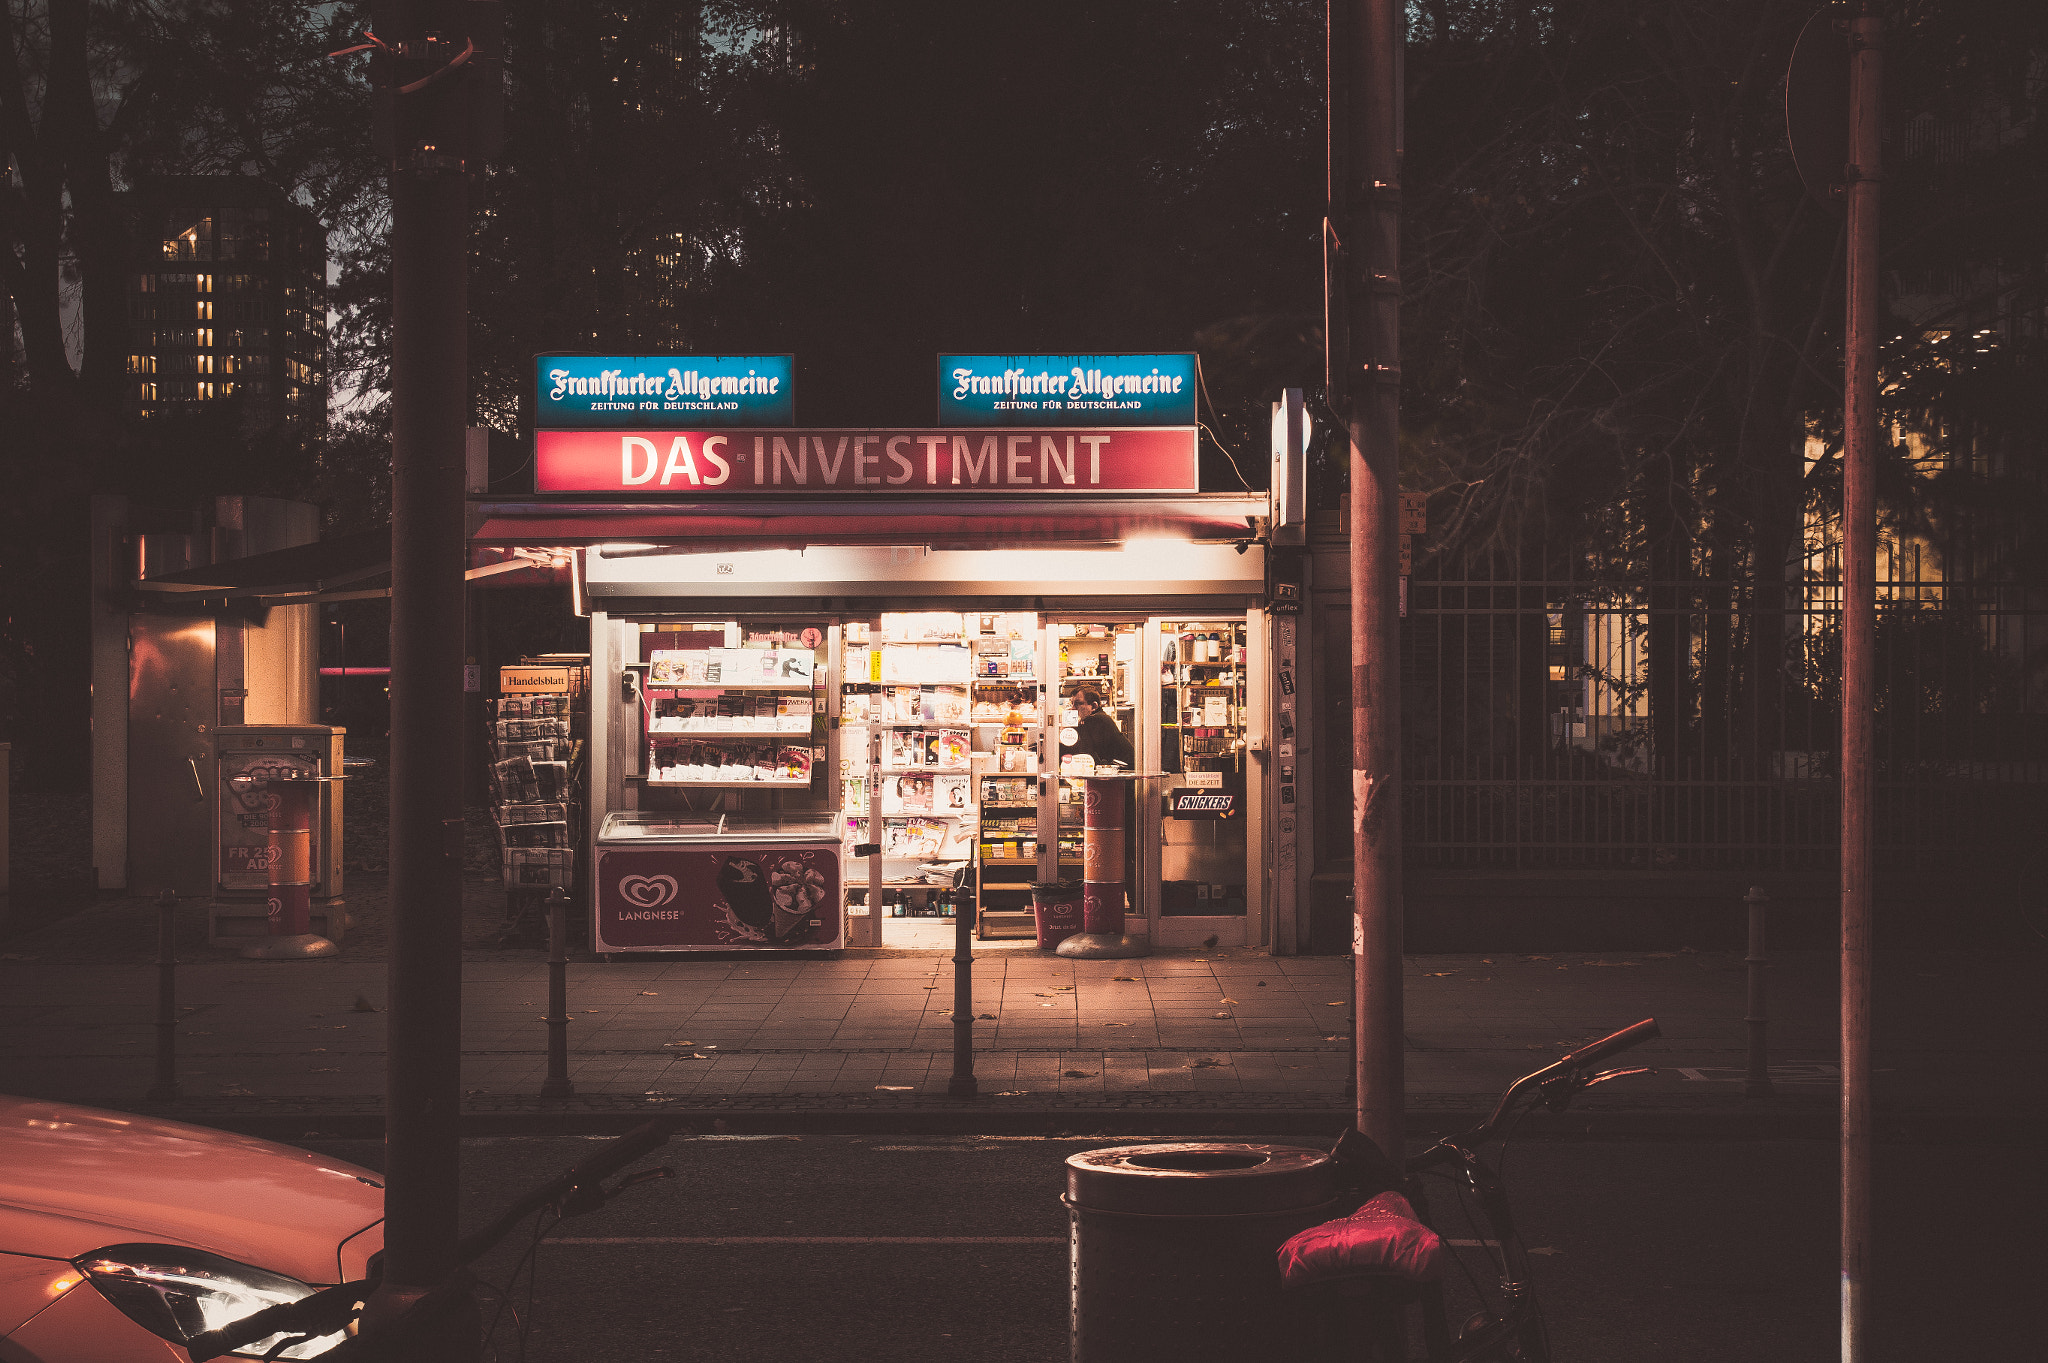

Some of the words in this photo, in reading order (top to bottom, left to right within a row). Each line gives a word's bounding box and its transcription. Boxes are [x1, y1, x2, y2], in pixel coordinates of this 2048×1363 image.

[549, 368, 666, 401] Frankfurter
[664, 367, 780, 401] Allgemeine
[952, 367, 1069, 400] Frankfurter
[1067, 366, 1184, 400] Allgemeine
[591, 402, 635, 411] ZEITUNG
[640, 400, 660, 411] FÜR
[664, 402, 739, 411] DEUTSCHLAND
[994, 401, 1039, 410] ZEITUNG
[1043, 399, 1063, 410] FÜR
[1067, 401, 1143, 410] DEUTSCHLAND
[621, 436, 731, 486] DAS
[754, 435, 1112, 485] INVESTMENT
[748, 631, 799, 643] Jägermster
[508, 676, 566, 687] Handelsblatt
[1178, 796, 1231, 809] SNICKERS
[228, 847, 249, 858] FR
[618, 910, 680, 921] LANGNESE
